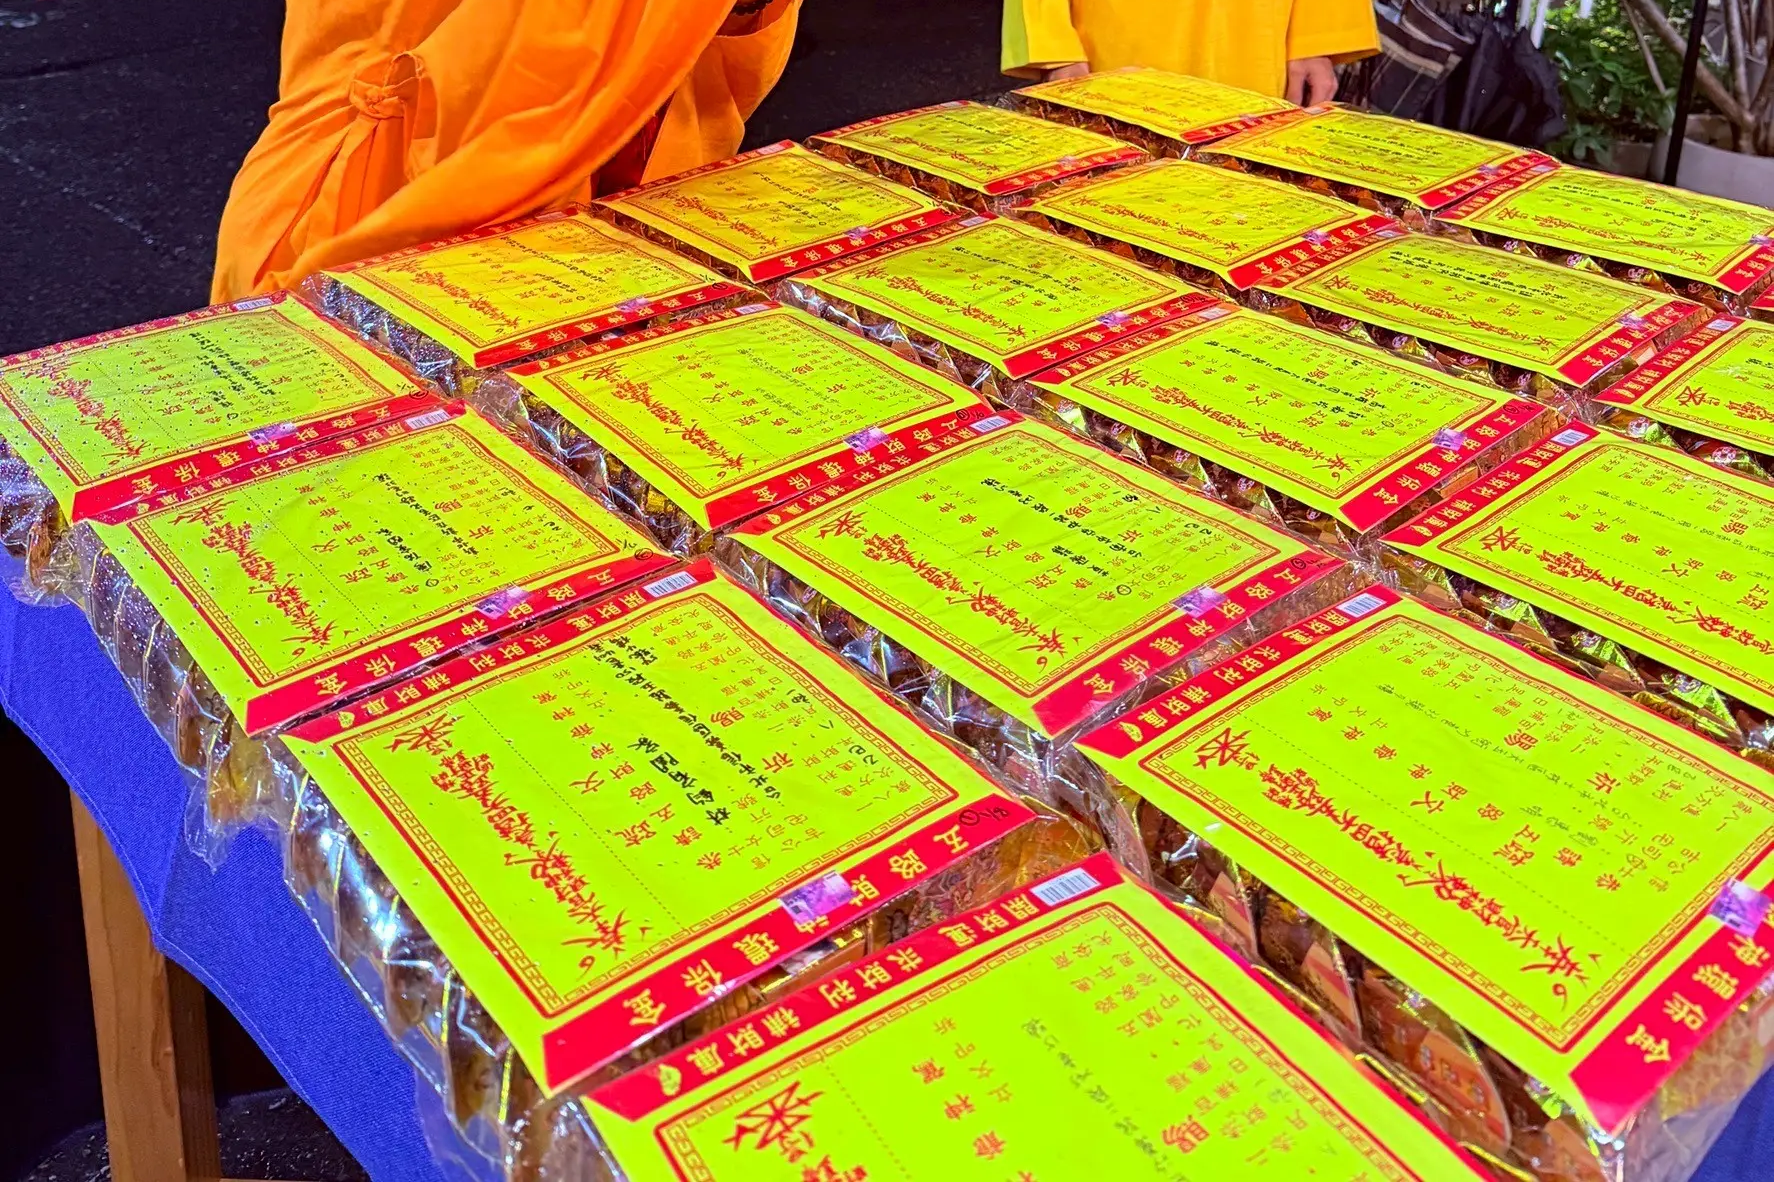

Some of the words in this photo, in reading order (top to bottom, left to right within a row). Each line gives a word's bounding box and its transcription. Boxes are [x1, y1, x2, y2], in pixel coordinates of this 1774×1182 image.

[619, 325, 679, 344] 求財利
[682, 309, 739, 327] 開財運
[550, 343, 614, 364] 補財庫
[333, 422, 407, 449] 開財運
[916, 427, 977, 454] 開財運
[1514, 441, 1568, 468] 開財運
[246, 449, 322, 476] 求財利
[849, 454, 914, 483] 求財利
[1366, 412, 1520, 505] 五路財神環保金
[155, 476, 234, 506] 補財庫
[779, 484, 849, 516] 補財庫
[1468, 468, 1523, 497] 求財利
[1419, 497, 1478, 529] 補財庫
[308, 537, 373, 585] 疏文
[971, 543, 1059, 591] 疏文
[1658, 562, 1770, 612] 疏文
[563, 591, 648, 631] 開財運
[1077, 564, 1305, 699] 五路財神環保金
[1279, 608, 1350, 647] 開財運
[466, 631, 552, 672] 求財利
[1209, 643, 1284, 685] 求財利
[360, 671, 453, 717] 補財庫
[1133, 683, 1214, 730] 補財庫
[1305, 682, 1391, 731] 立文叩祈
[529, 687, 728, 872] 恭請五路財神爺神駕
[1302, 703, 1627, 896] 恭請五路財神爺神駕
[566, 770, 658, 849] 疏文
[1406, 788, 1536, 870] 疏文
[946, 894, 1032, 949] 開財運
[819, 945, 923, 1006] 求財利
[685, 1006, 799, 1073] 補財庫
[933, 1017, 1014, 1103] 立文叩祈
